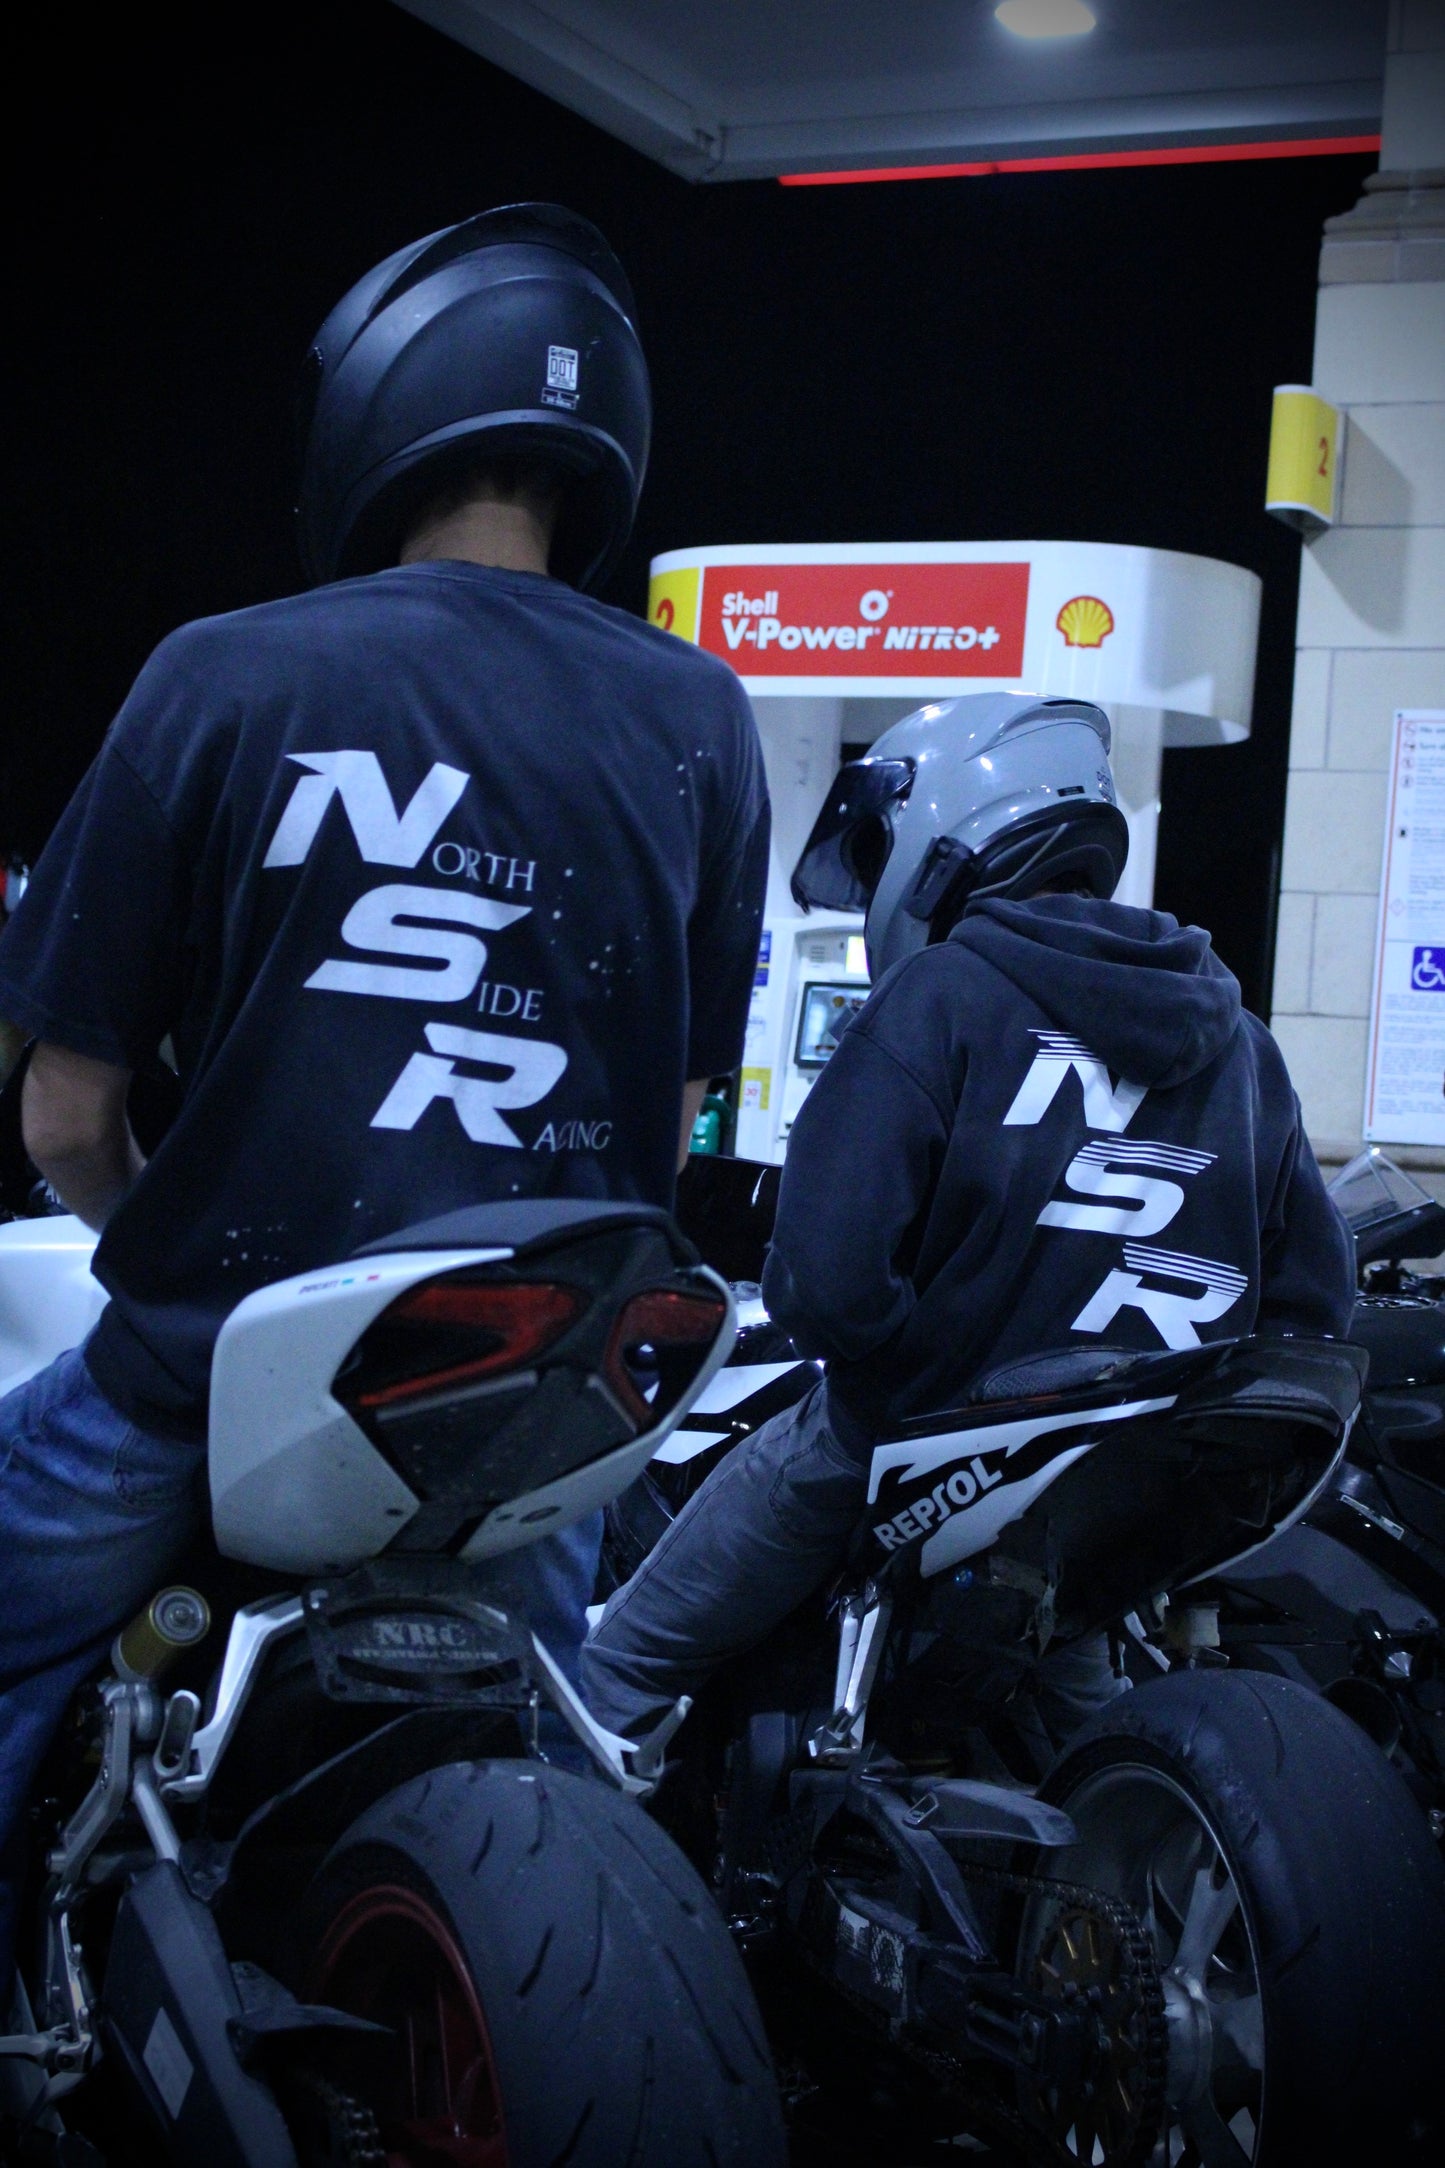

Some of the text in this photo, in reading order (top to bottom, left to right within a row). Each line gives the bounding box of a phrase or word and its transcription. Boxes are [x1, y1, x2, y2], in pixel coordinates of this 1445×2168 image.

[551, 358, 575, 379] DOT
[1317, 437, 1329, 477] 2
[722, 591, 778, 616] Shell
[721, 618, 1000, 650] V-Power NITRO+
[873, 1456, 1003, 1550] REPSOL
[373, 1621, 467, 1646] NRC
